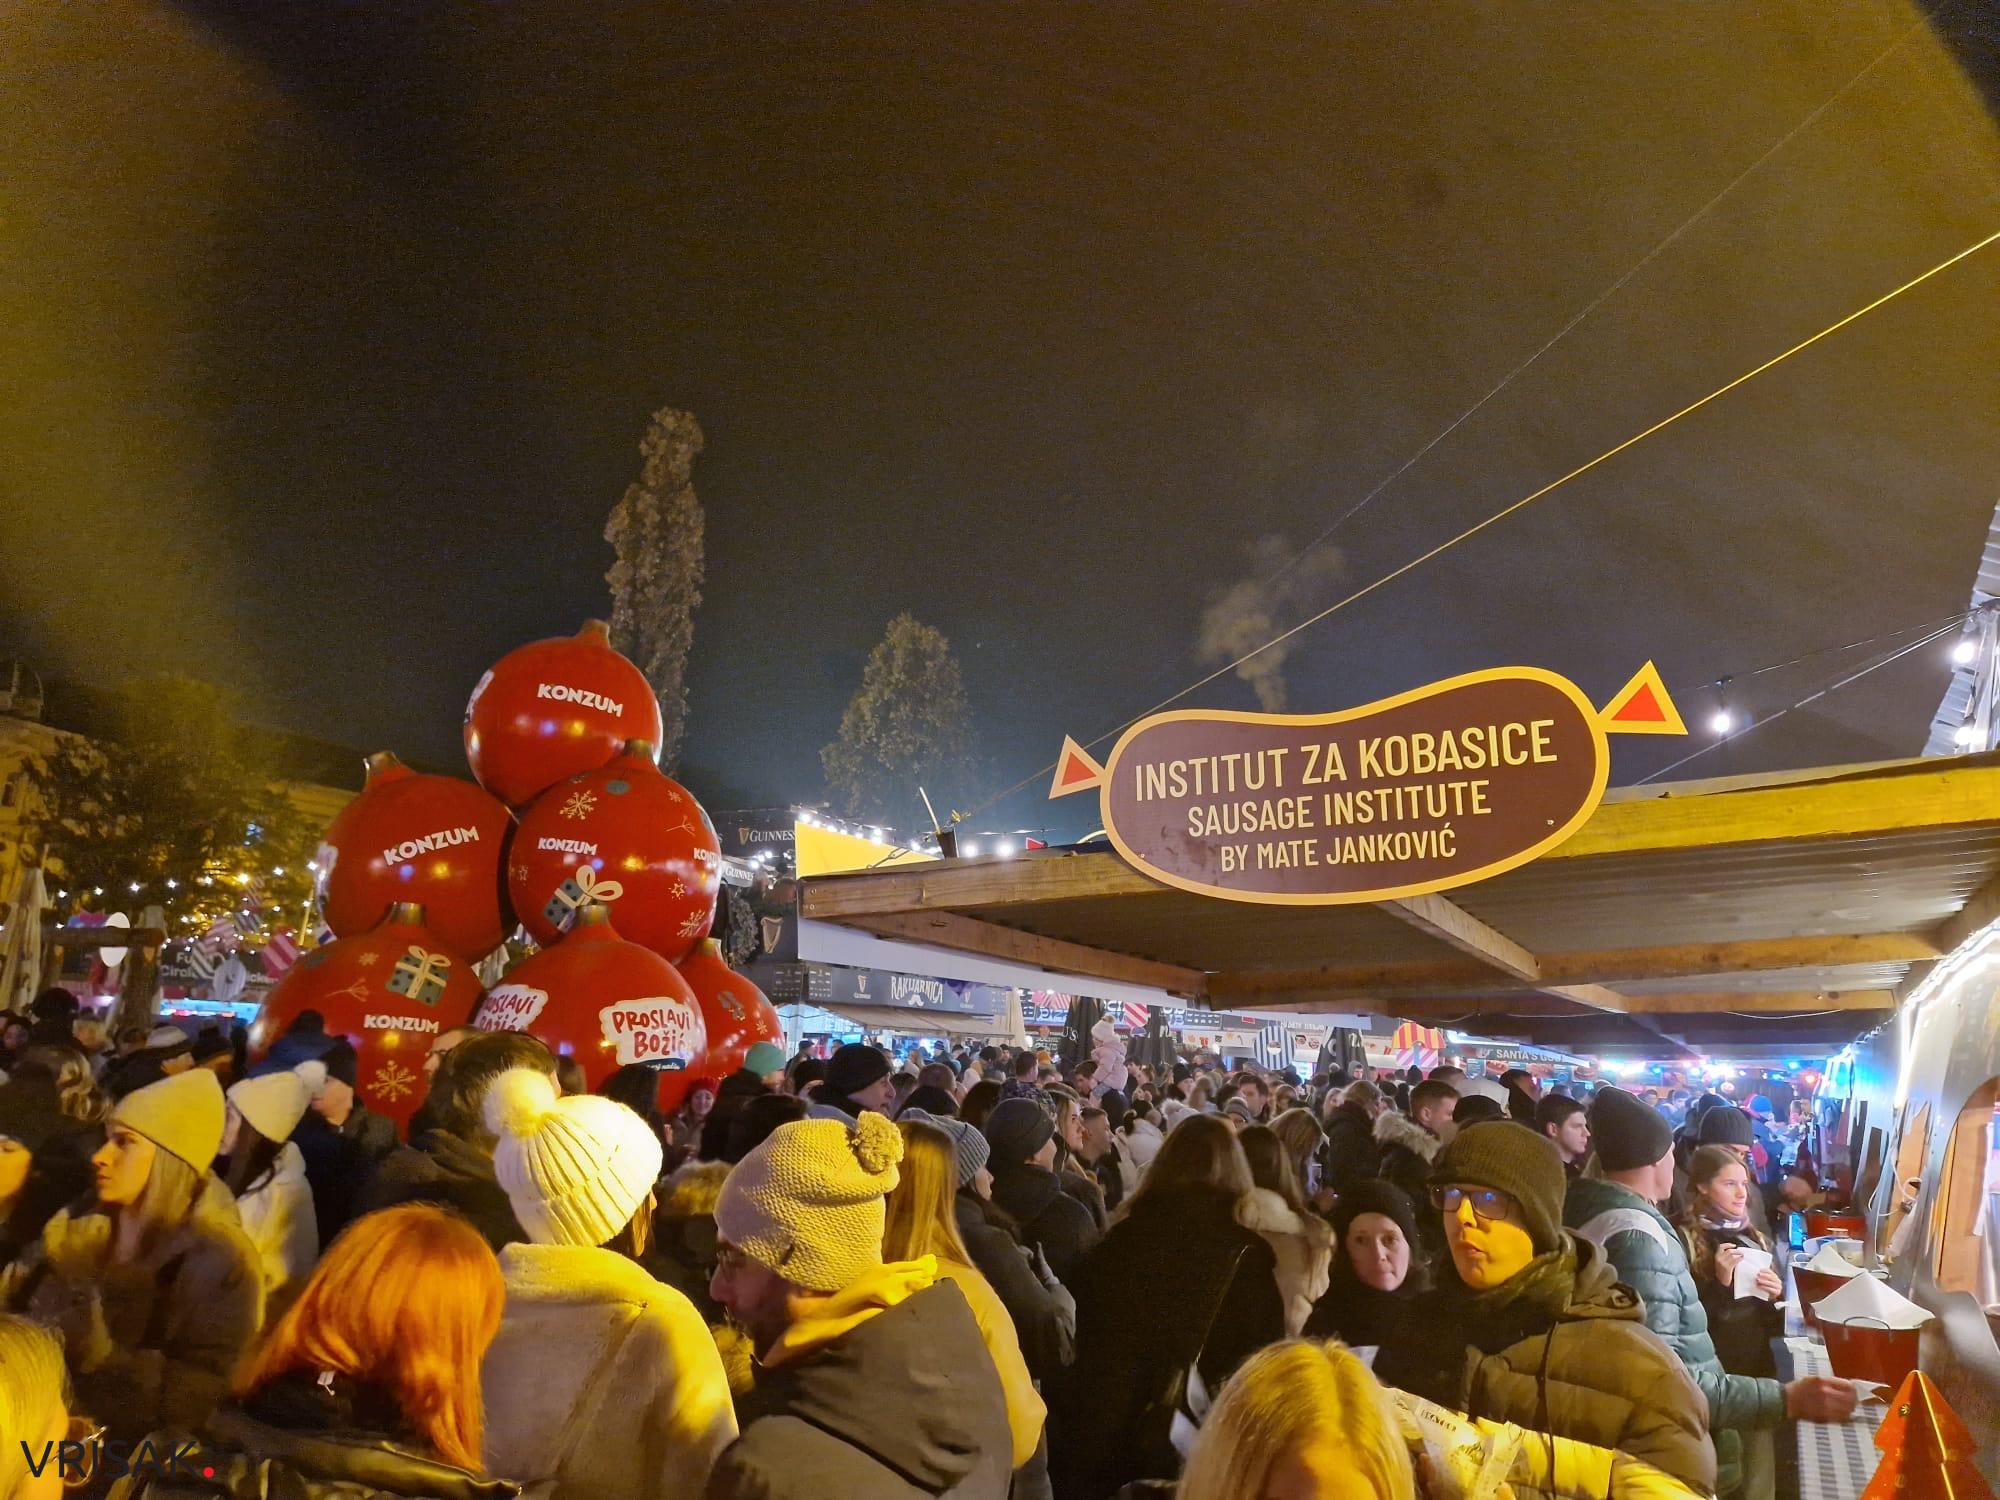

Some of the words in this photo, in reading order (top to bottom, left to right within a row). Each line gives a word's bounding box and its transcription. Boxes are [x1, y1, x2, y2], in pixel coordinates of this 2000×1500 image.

[537, 683, 624, 717] KONZUM
[1135, 748, 1289, 802] INSTITUT
[1300, 742, 1348, 785] ZA
[1359, 719, 1558, 779] KOBASICE
[1188, 795, 1315, 838] SAUSAGE
[1324, 779, 1492, 827] INSTITUTE
[383, 826, 480, 866] KONZUM
[538, 837, 598, 856] KONZUM
[1220, 844, 1248, 873] BY
[1257, 839, 1319, 870] MATE
[1326, 822, 1457, 866] JANKOVIĆ
[363, 1014, 440, 1034] KONZUM
